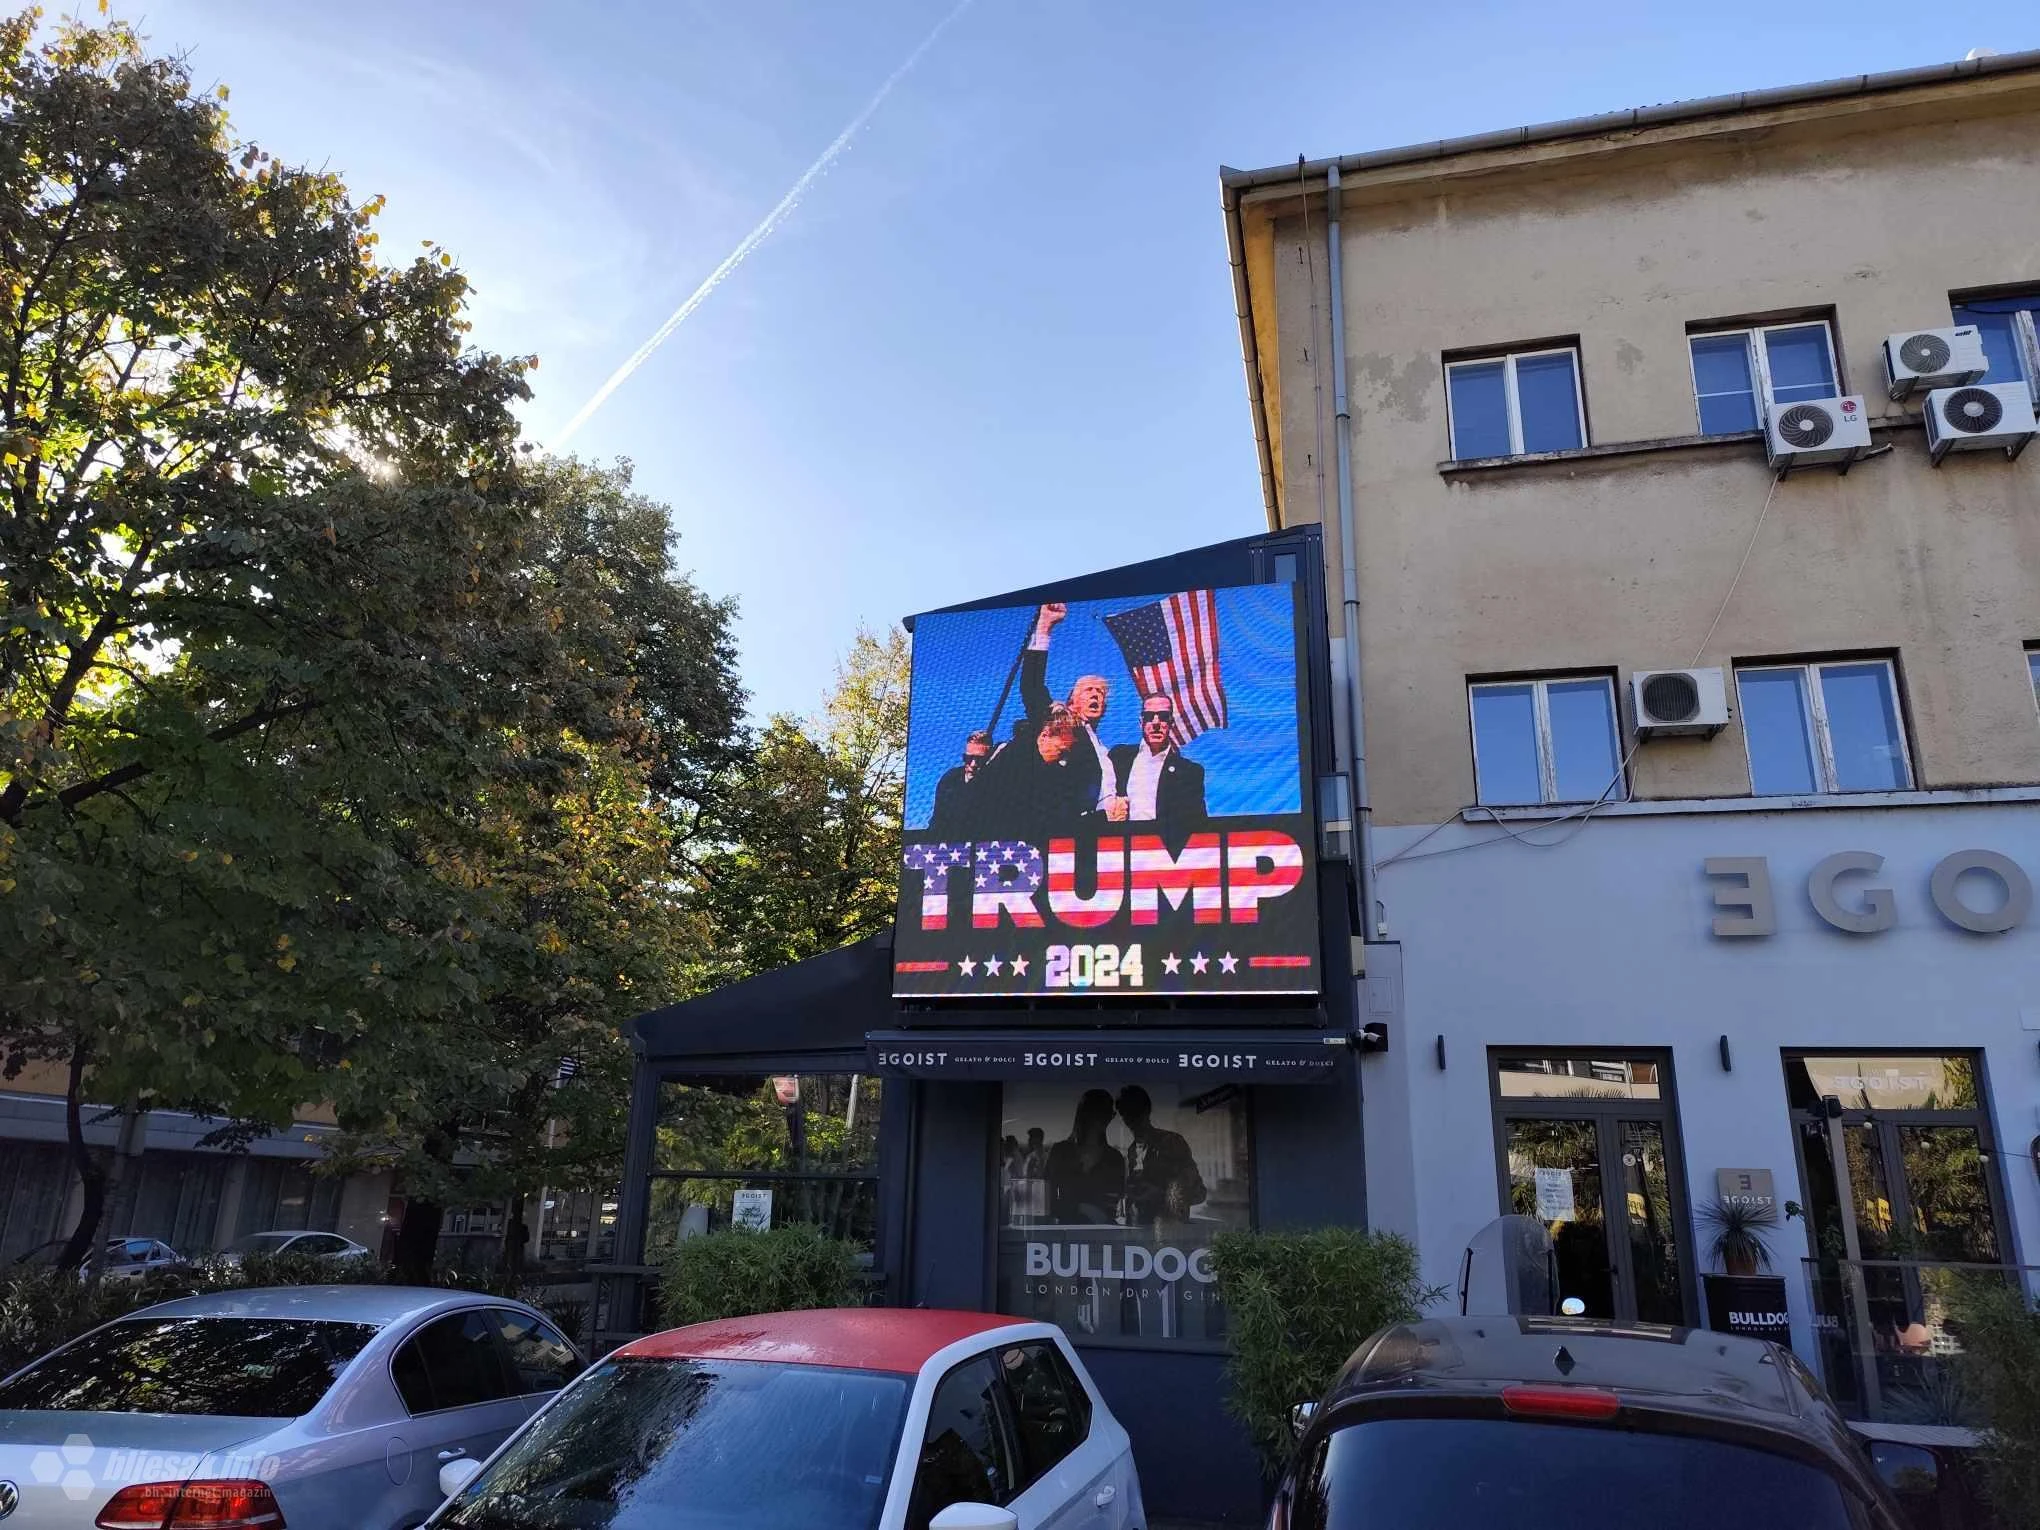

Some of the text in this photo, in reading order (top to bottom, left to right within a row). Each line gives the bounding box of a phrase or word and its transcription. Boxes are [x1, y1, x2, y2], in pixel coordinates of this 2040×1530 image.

[904, 831, 1303, 930] TRUMP
[1046, 944, 1144, 987] 2024
[1026, 1243, 1218, 1283] BULLDOG
[1025, 1284, 1111, 1296] LONDON
[1126, 1288, 1164, 1299] DRY
